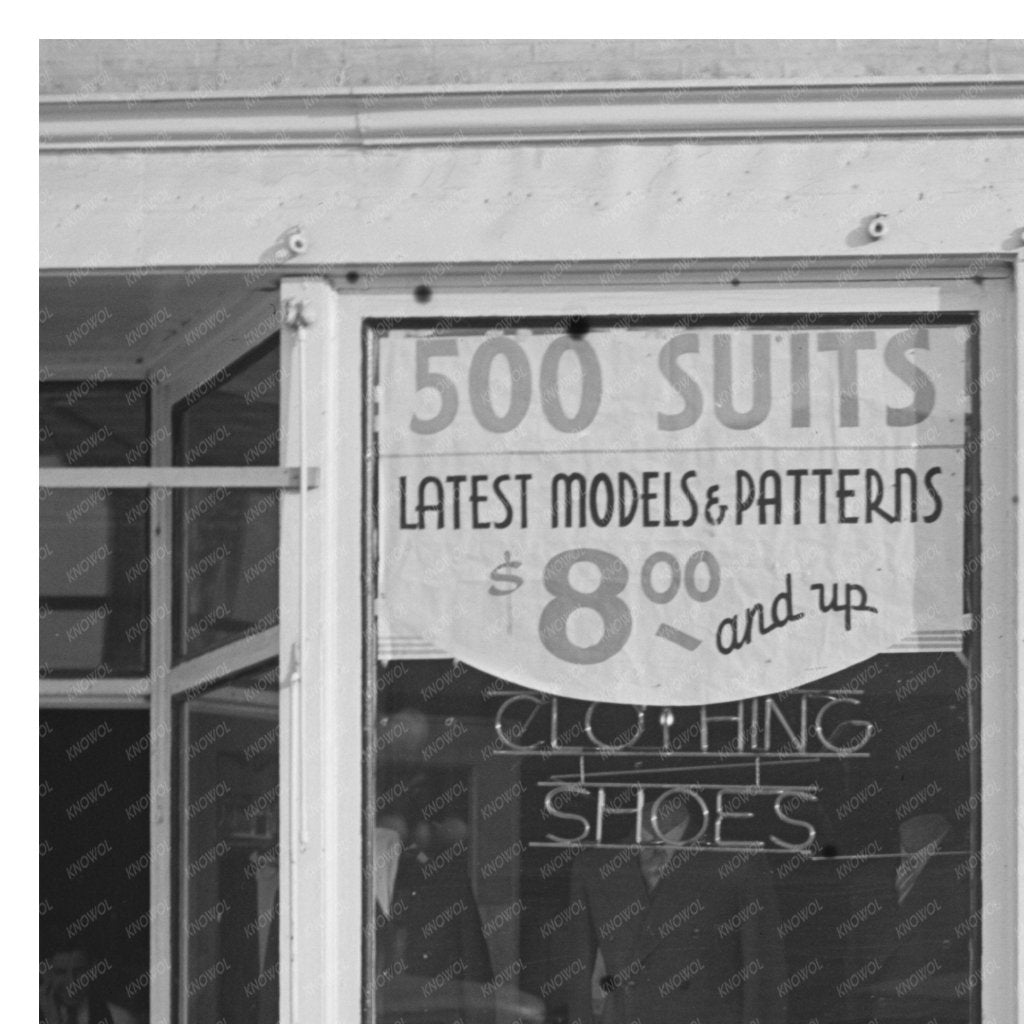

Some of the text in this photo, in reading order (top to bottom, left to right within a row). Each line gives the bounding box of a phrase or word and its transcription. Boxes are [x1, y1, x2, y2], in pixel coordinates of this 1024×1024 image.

[409, 331, 937, 436] 500 SUITS
[399, 474, 533, 530] LATEST
[716, 573, 804, 656] and
[810, 581, 880, 632] up
[495, 693, 874, 754] CLOTHING
[545, 784, 819, 850] SHOES
